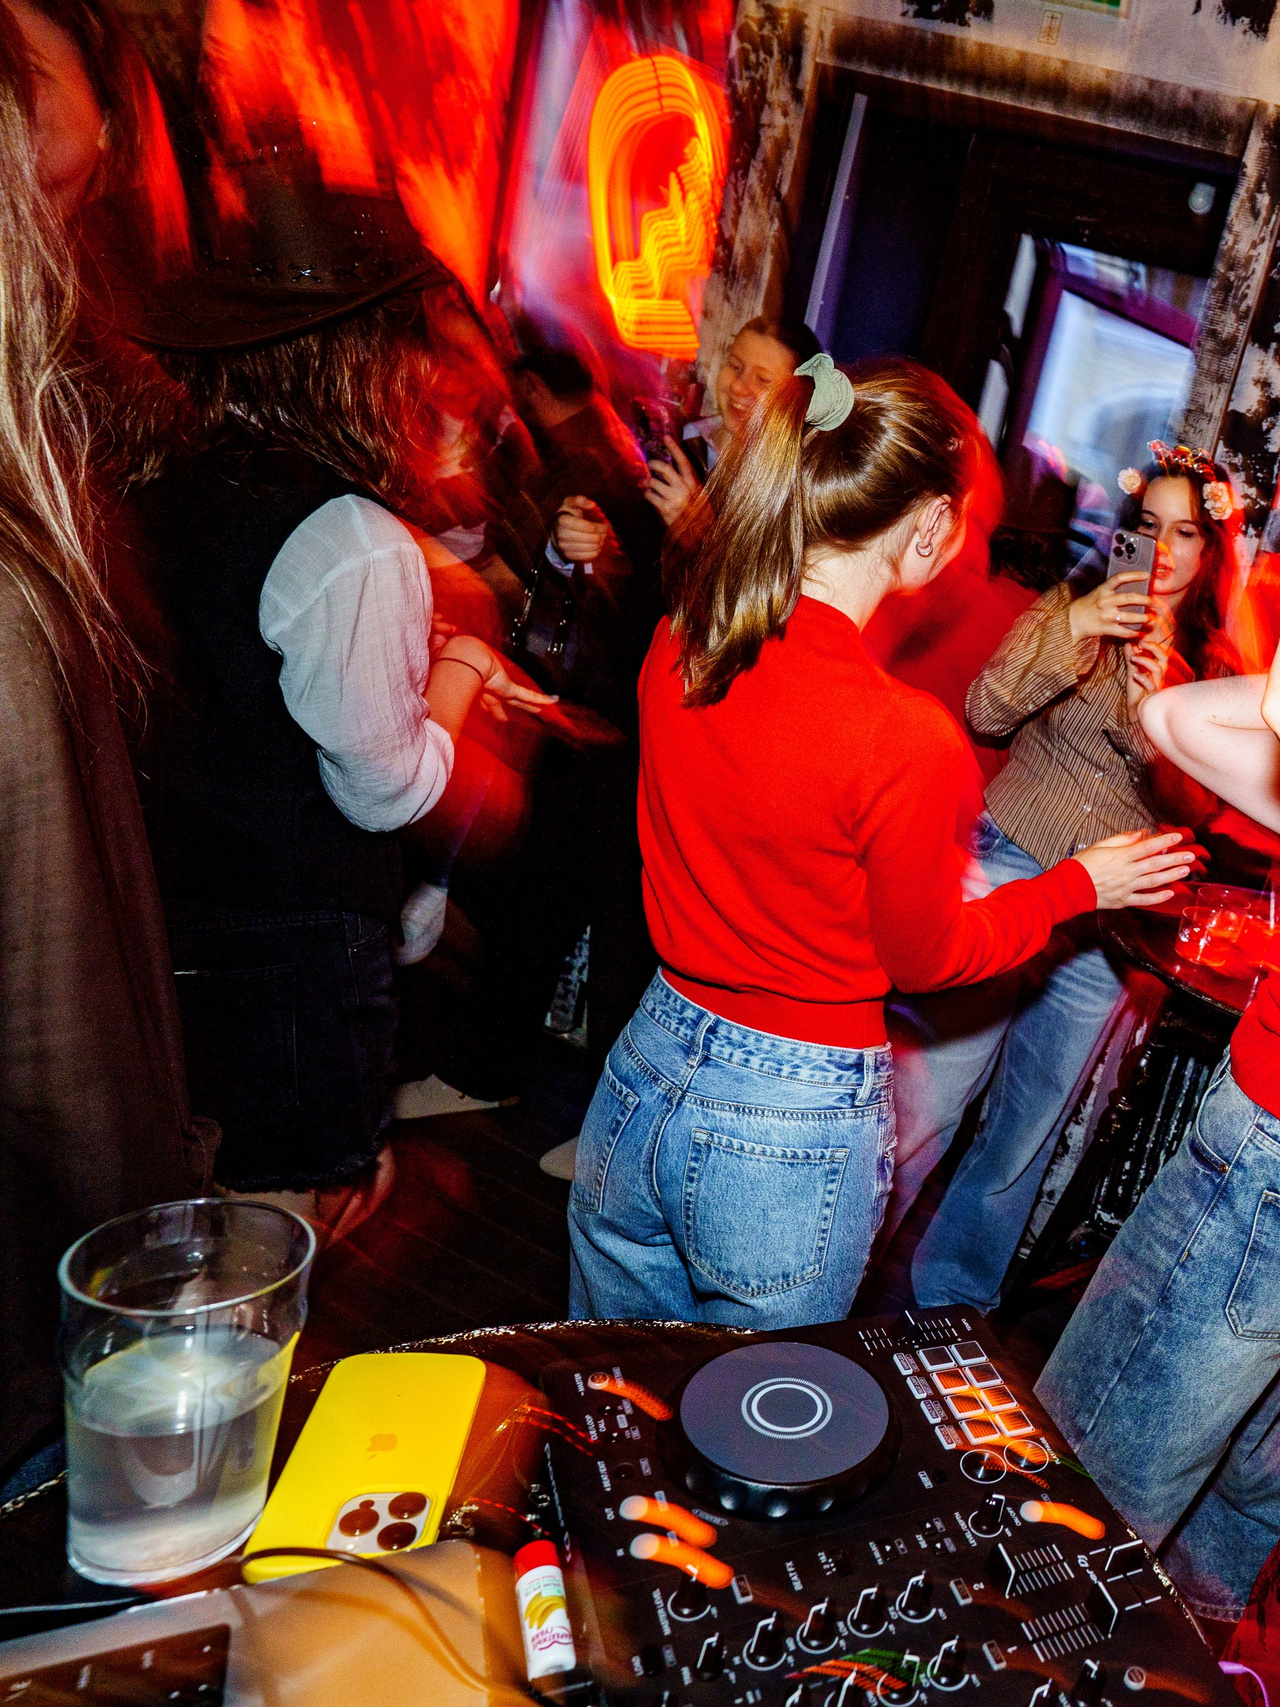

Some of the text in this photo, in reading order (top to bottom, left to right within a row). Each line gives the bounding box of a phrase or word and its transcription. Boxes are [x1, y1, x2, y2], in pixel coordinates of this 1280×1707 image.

[585, 1414, 598, 1440] CUE/LOOP
[598, 1419, 606, 1432] CALL
[605, 1508, 614, 1520] OUT
[1006, 1507, 1021, 1526] ON/OFF
[954, 1512, 977, 1546] LEVEL/DEPTH
[916, 1534, 927, 1548] BEAT
[789, 1572, 803, 1591] BEAT
[973, 1582, 984, 1590] 2
[1007, 1645, 1017, 1653] 1
